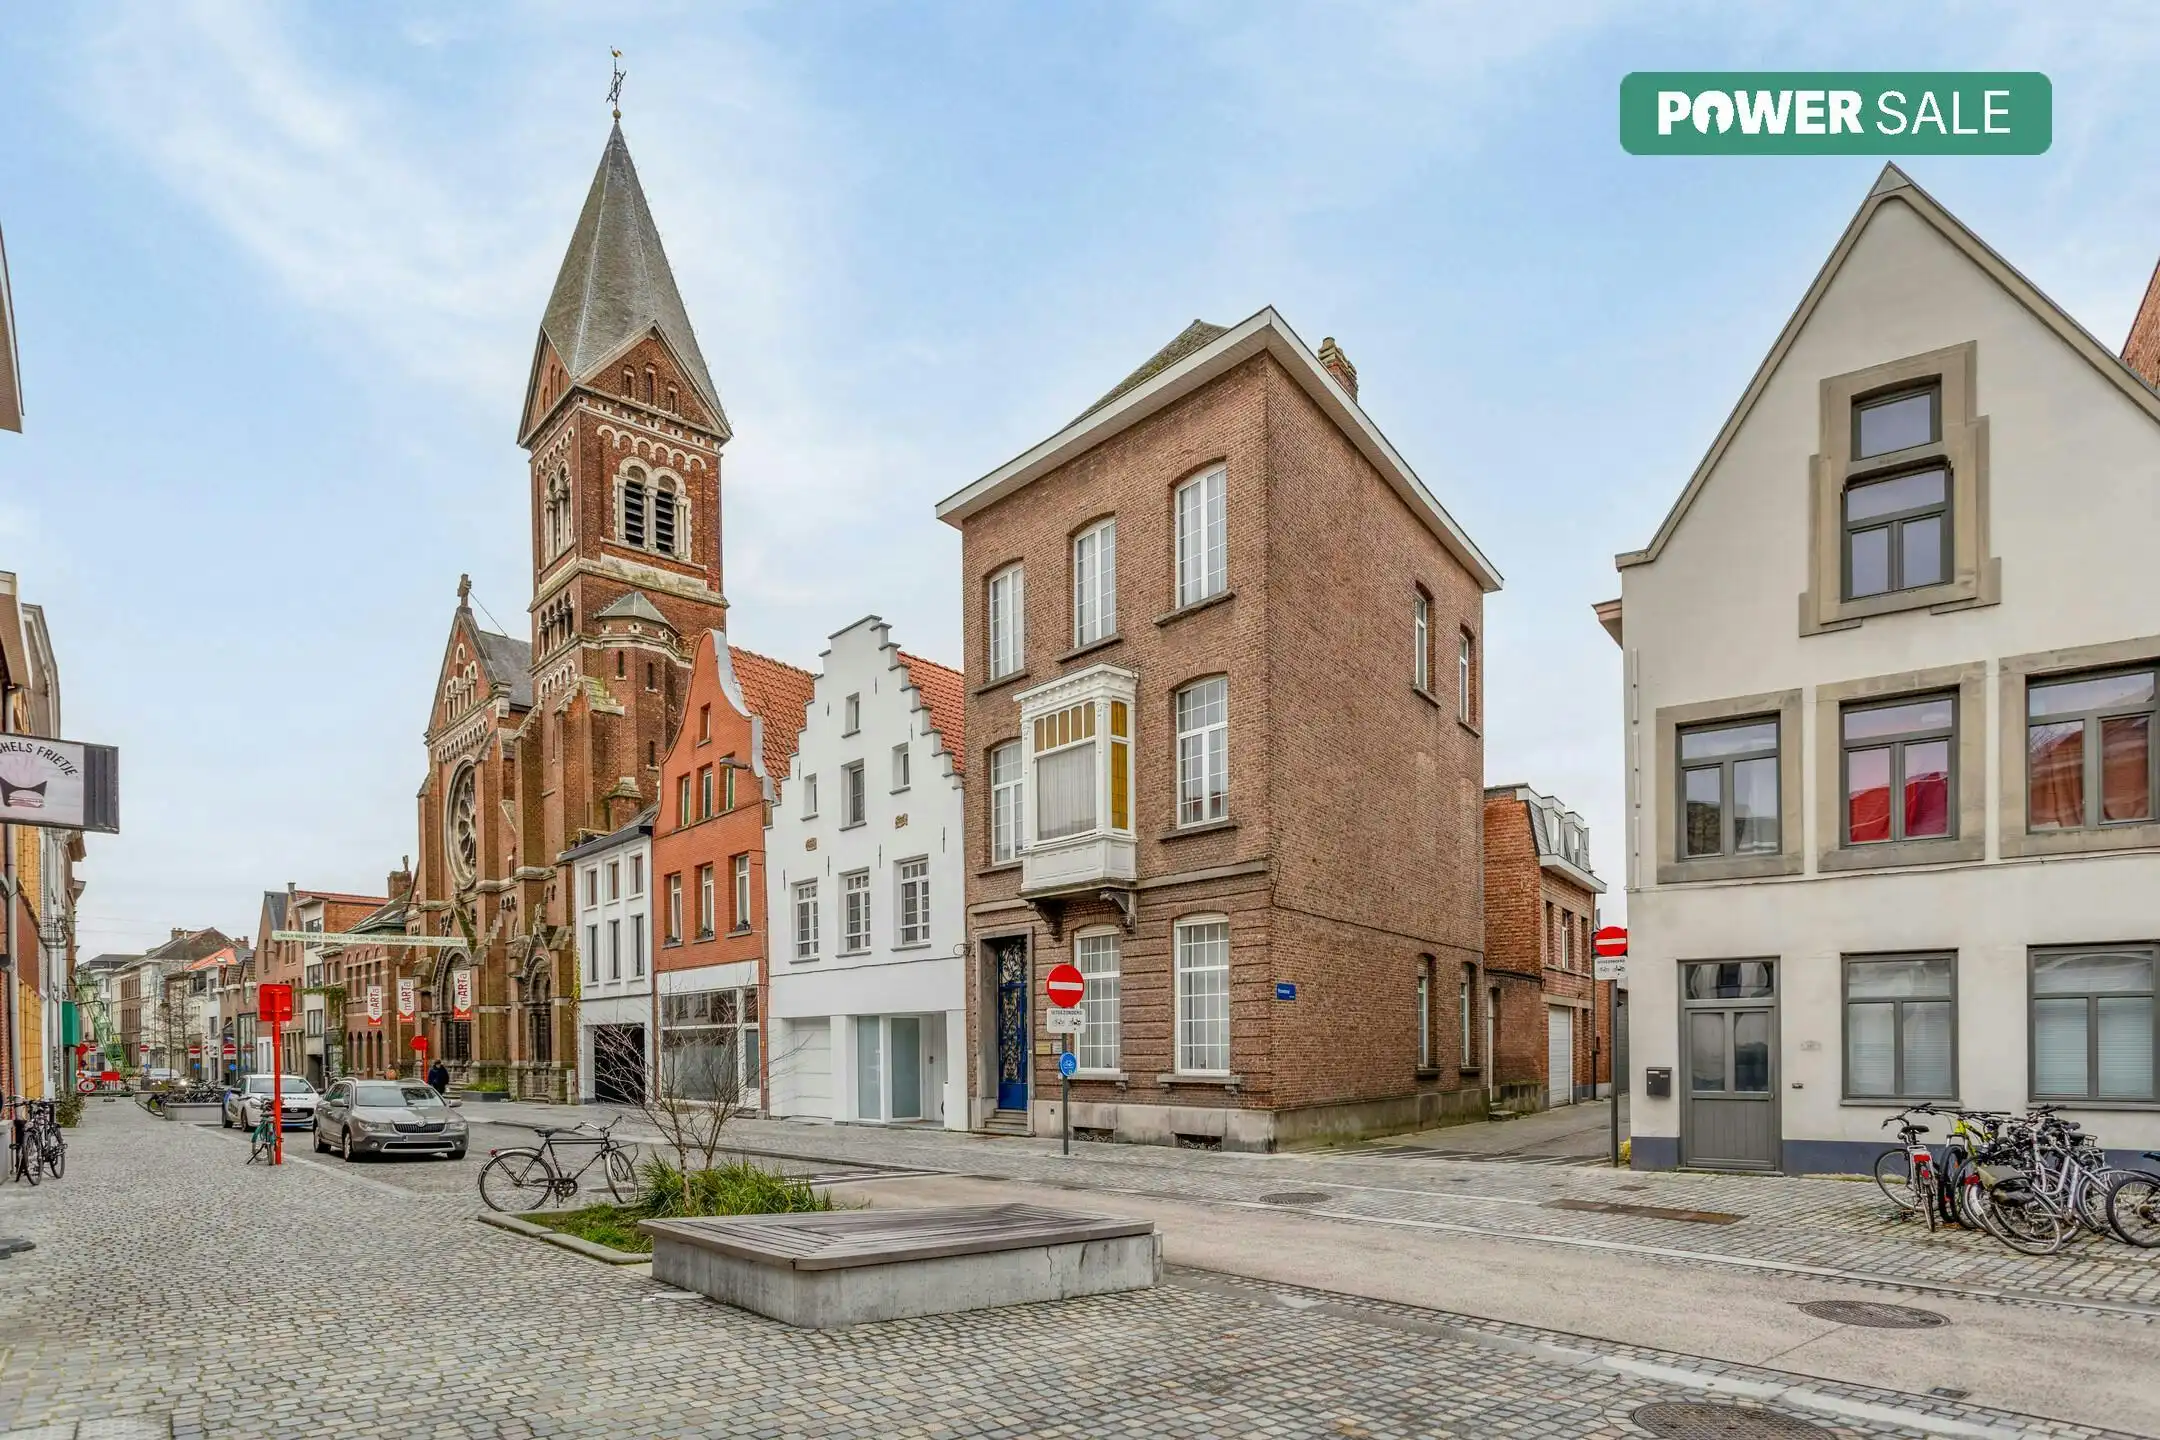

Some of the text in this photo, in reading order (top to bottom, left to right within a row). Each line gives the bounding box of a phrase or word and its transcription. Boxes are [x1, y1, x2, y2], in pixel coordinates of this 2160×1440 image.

[36, 745, 78, 776] FRIETJE
[401, 981, 411, 1011] mARTa
[457, 973, 468, 1006] mARTa
